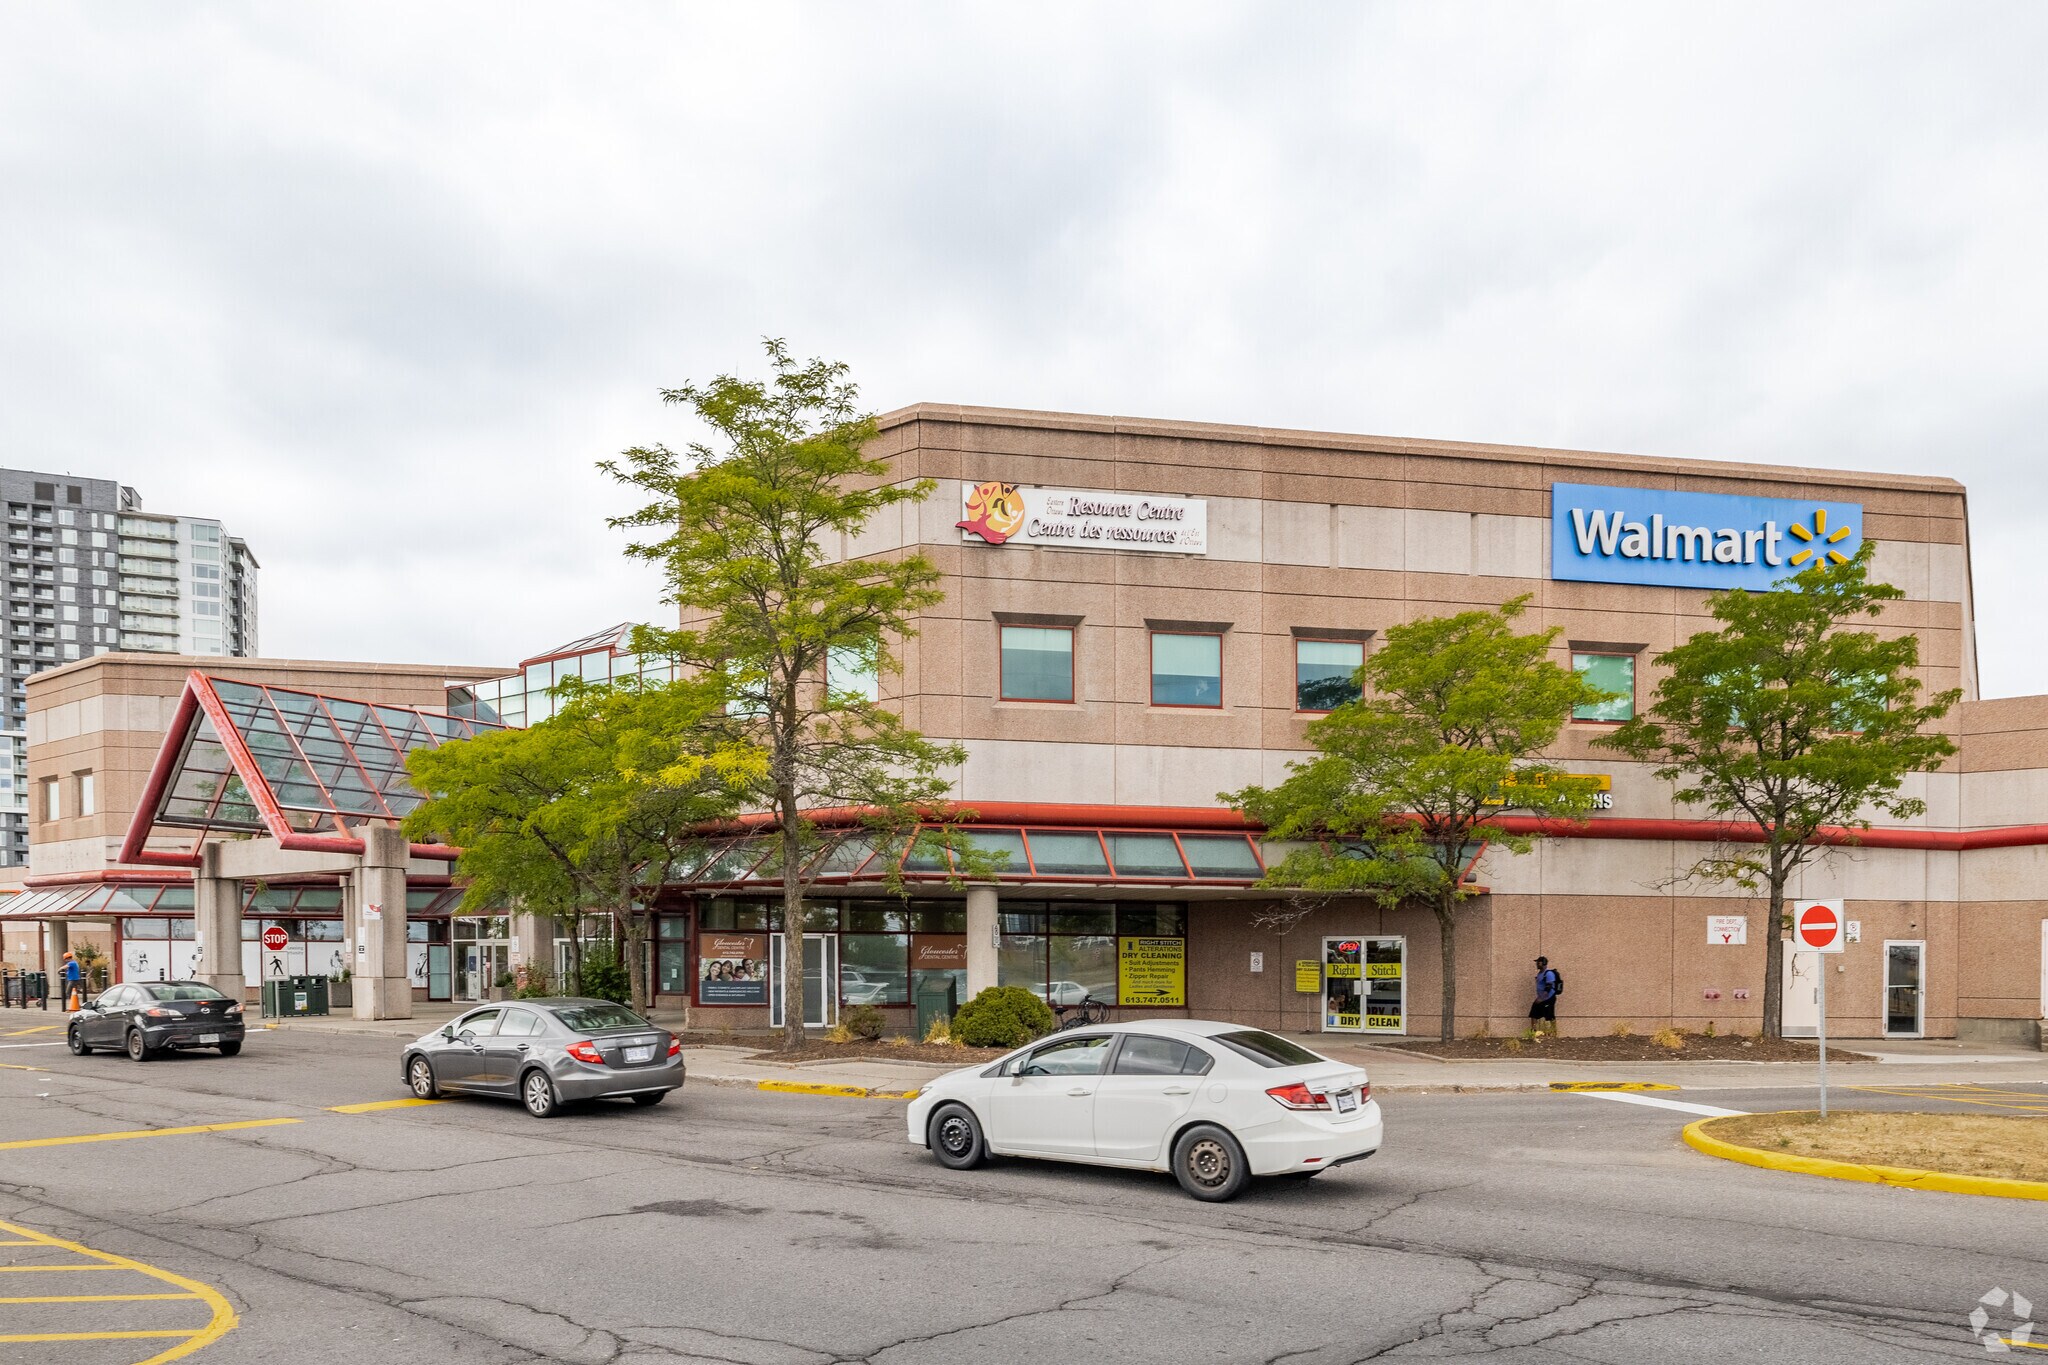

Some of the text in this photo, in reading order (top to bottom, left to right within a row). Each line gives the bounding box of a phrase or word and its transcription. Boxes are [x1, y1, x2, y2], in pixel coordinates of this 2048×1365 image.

[1067, 496, 1185, 521] Resource Centre
[1027, 518, 1177, 544] Centre des ressources
[1568, 508, 1782, 567] Walmart
[264, 934, 287, 944] STOP
[919, 945, 958, 959] Gloucester
[1340, 942, 1359, 952] OPEN
[1332, 964, 1356, 977] Right
[1371, 964, 1397, 976] Stitch
[1340, 1016, 1361, 1026] DRY
[1368, 1017, 1400, 1027] CLEAN
